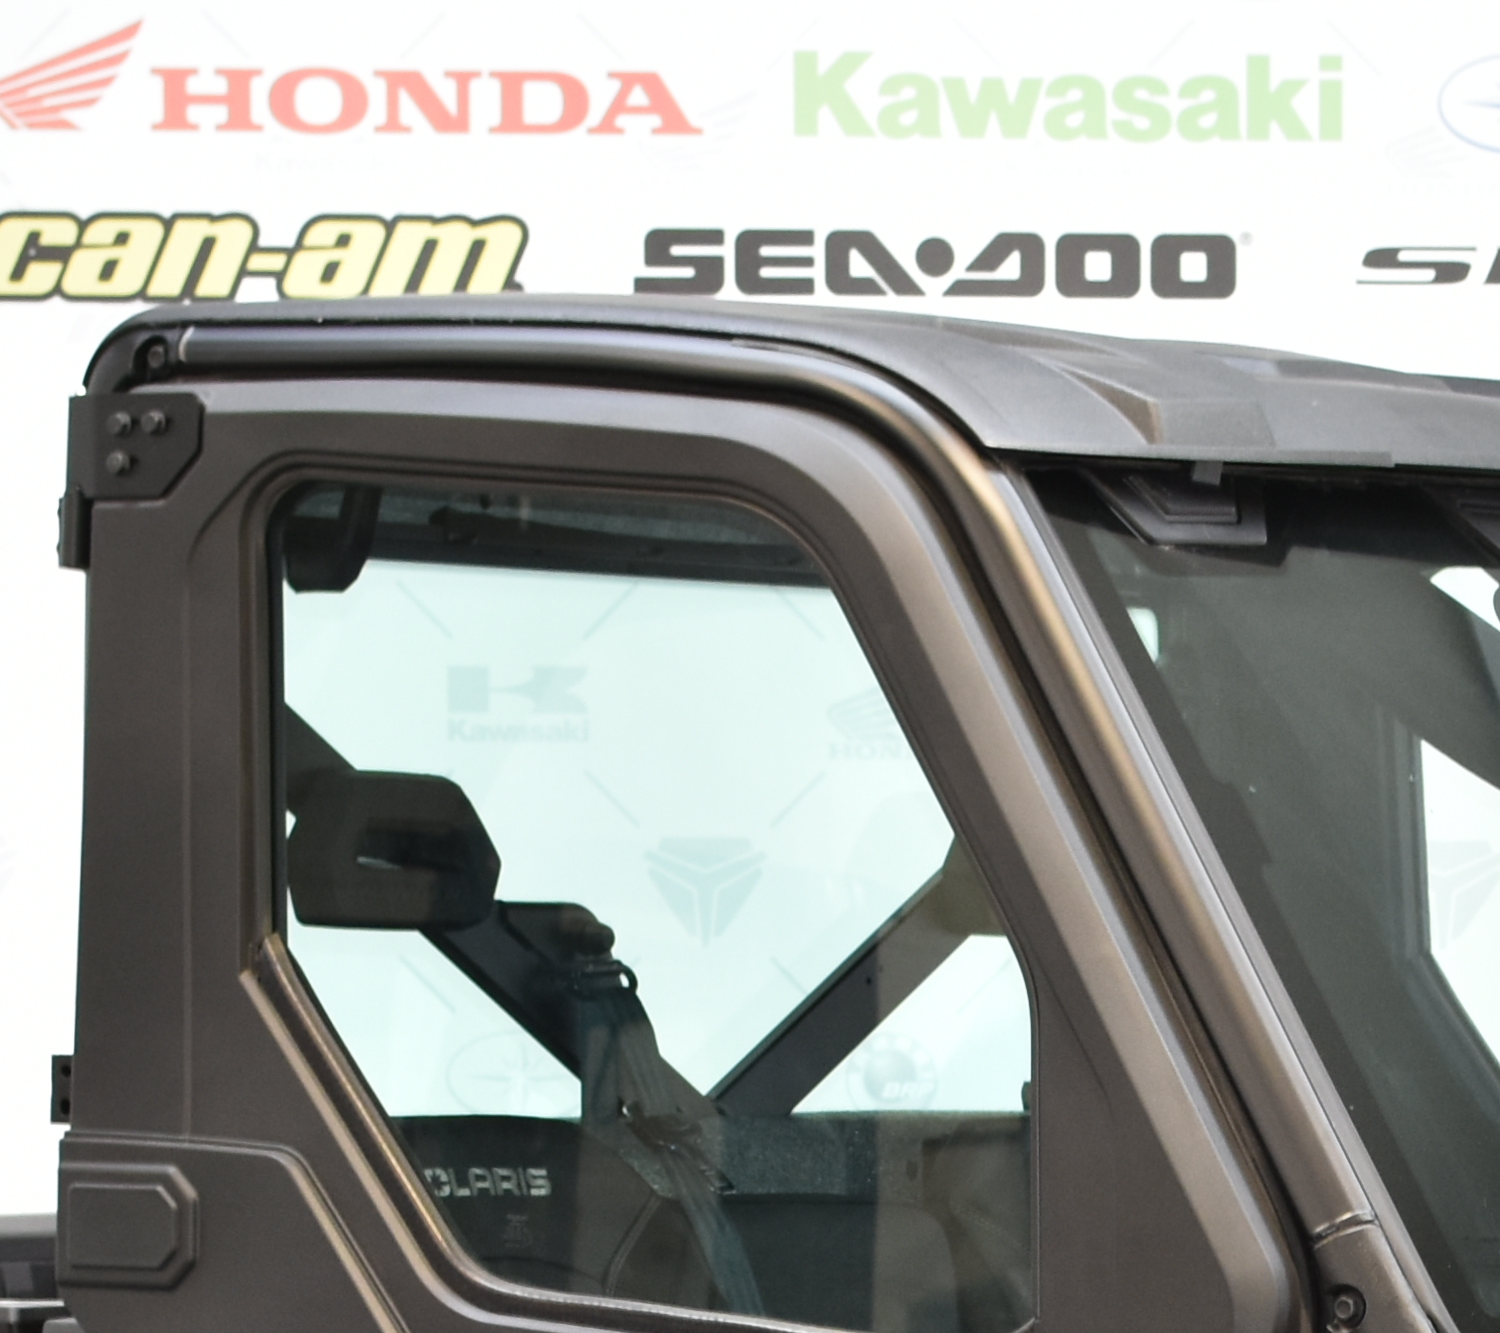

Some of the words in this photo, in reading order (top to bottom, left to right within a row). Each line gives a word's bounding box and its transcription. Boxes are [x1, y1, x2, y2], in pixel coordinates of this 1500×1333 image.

[150, 66, 703, 137] HONDA
[791, 50, 1344, 144] Kawasaki
[828, 742, 901, 760] HON
[424, 1167, 551, 1197] OLARIS
